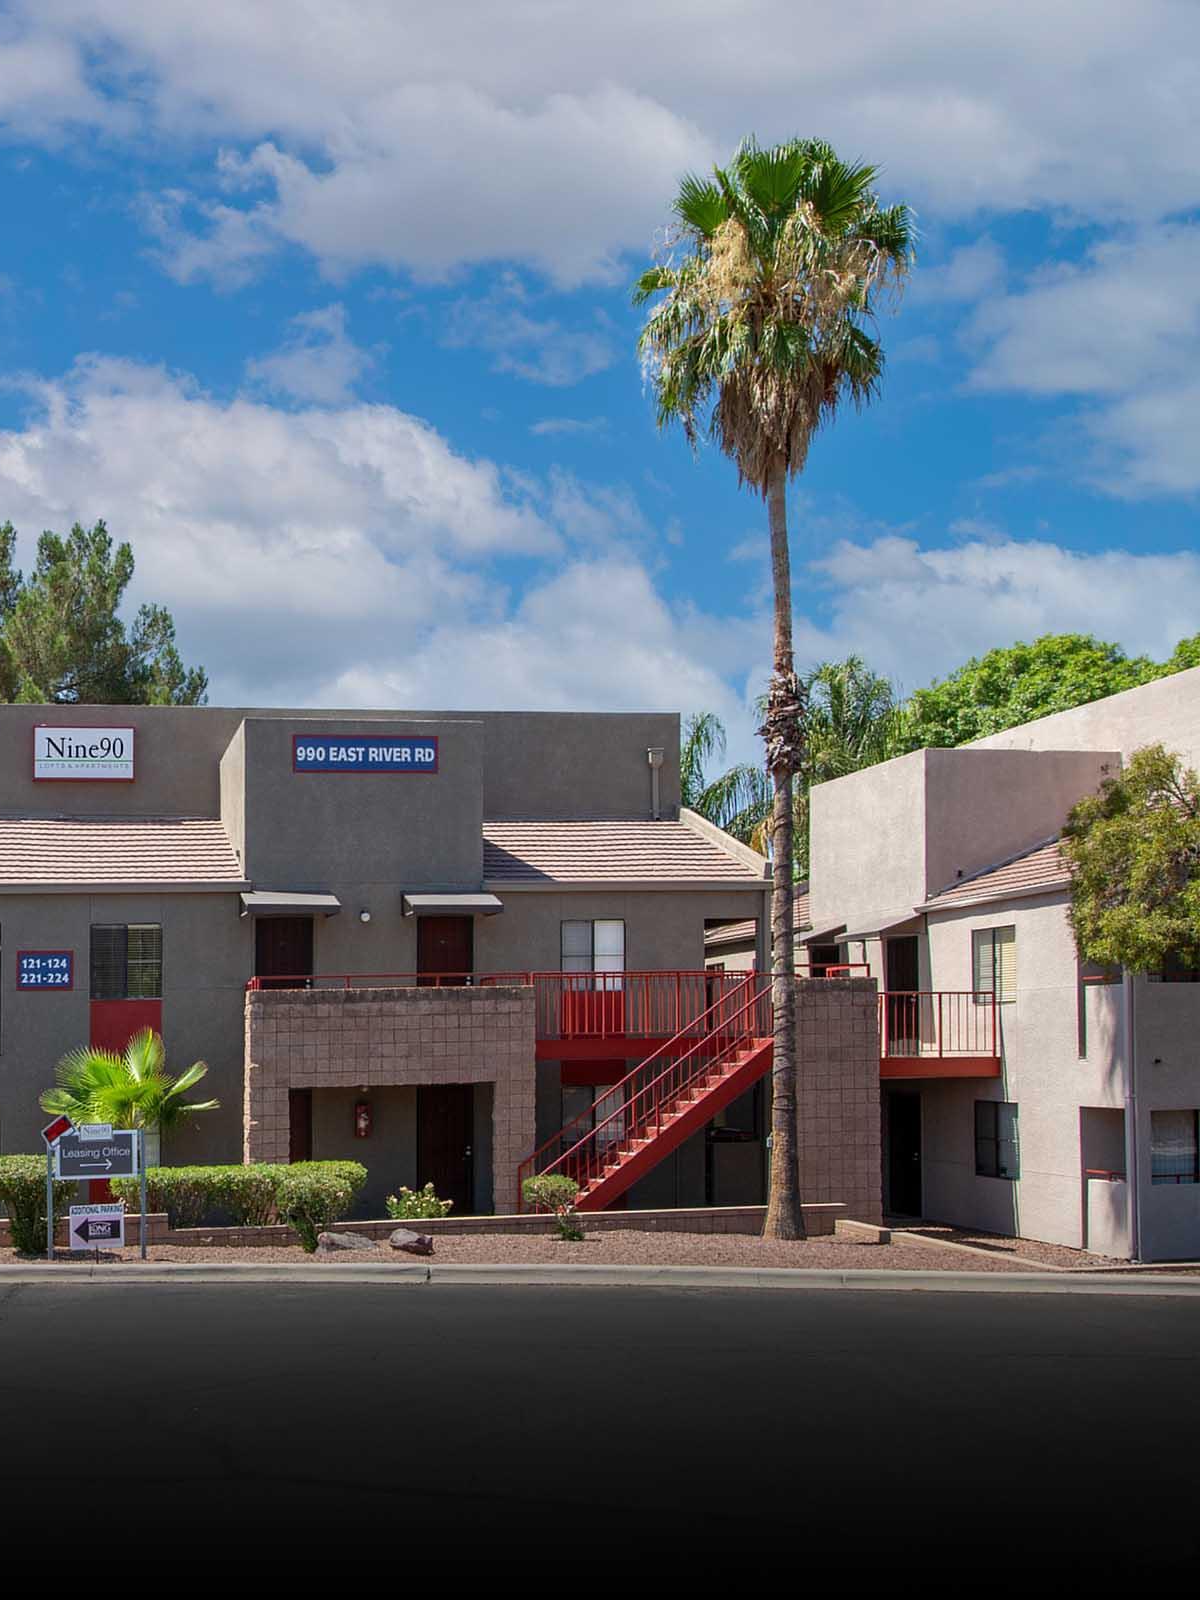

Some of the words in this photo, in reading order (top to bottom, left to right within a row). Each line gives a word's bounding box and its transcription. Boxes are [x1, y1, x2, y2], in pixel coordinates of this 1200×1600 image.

[45, 737, 124, 759] Nine90
[296, 747, 326, 761] 990
[329, 747, 365, 762] EAST
[368, 748, 411, 762] RIVER
[414, 748, 435, 762] RD
[22, 958, 67, 969] 121-124
[21, 973, 69, 984] 221-224
[62, 1148, 100, 1159] Leasing
[102, 1147, 130, 1157] Office
[71, 1206, 100, 1215] ADDITIONAL
[100, 1204, 123, 1213] PARKING
